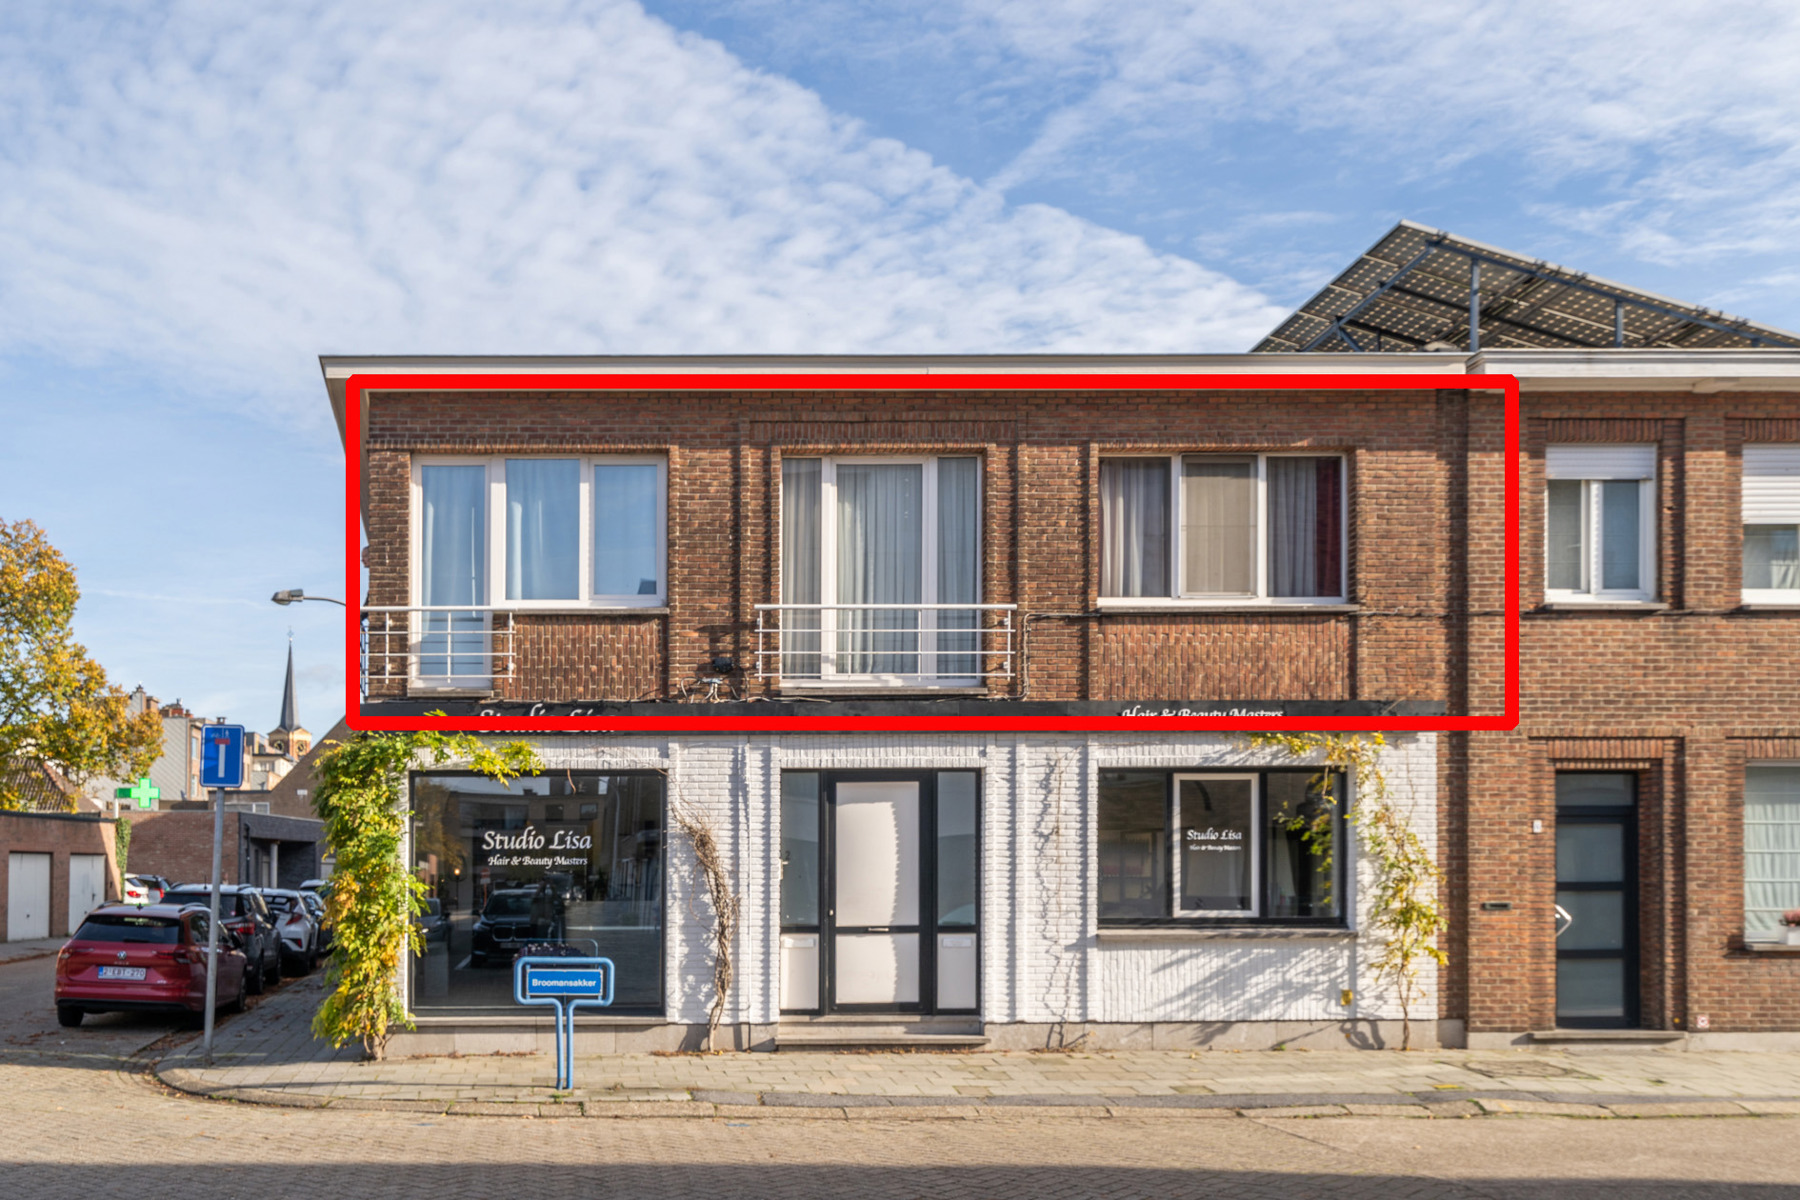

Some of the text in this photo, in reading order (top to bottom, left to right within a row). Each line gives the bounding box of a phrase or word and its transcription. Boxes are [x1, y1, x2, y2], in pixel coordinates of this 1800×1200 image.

[482, 826, 592, 850] Studio Lisa
[1186, 827, 1242, 840] Studio Lisa
[487, 854, 589, 870] Hair & Beauty Masters
[532, 979, 597, 987] Broomansakker
